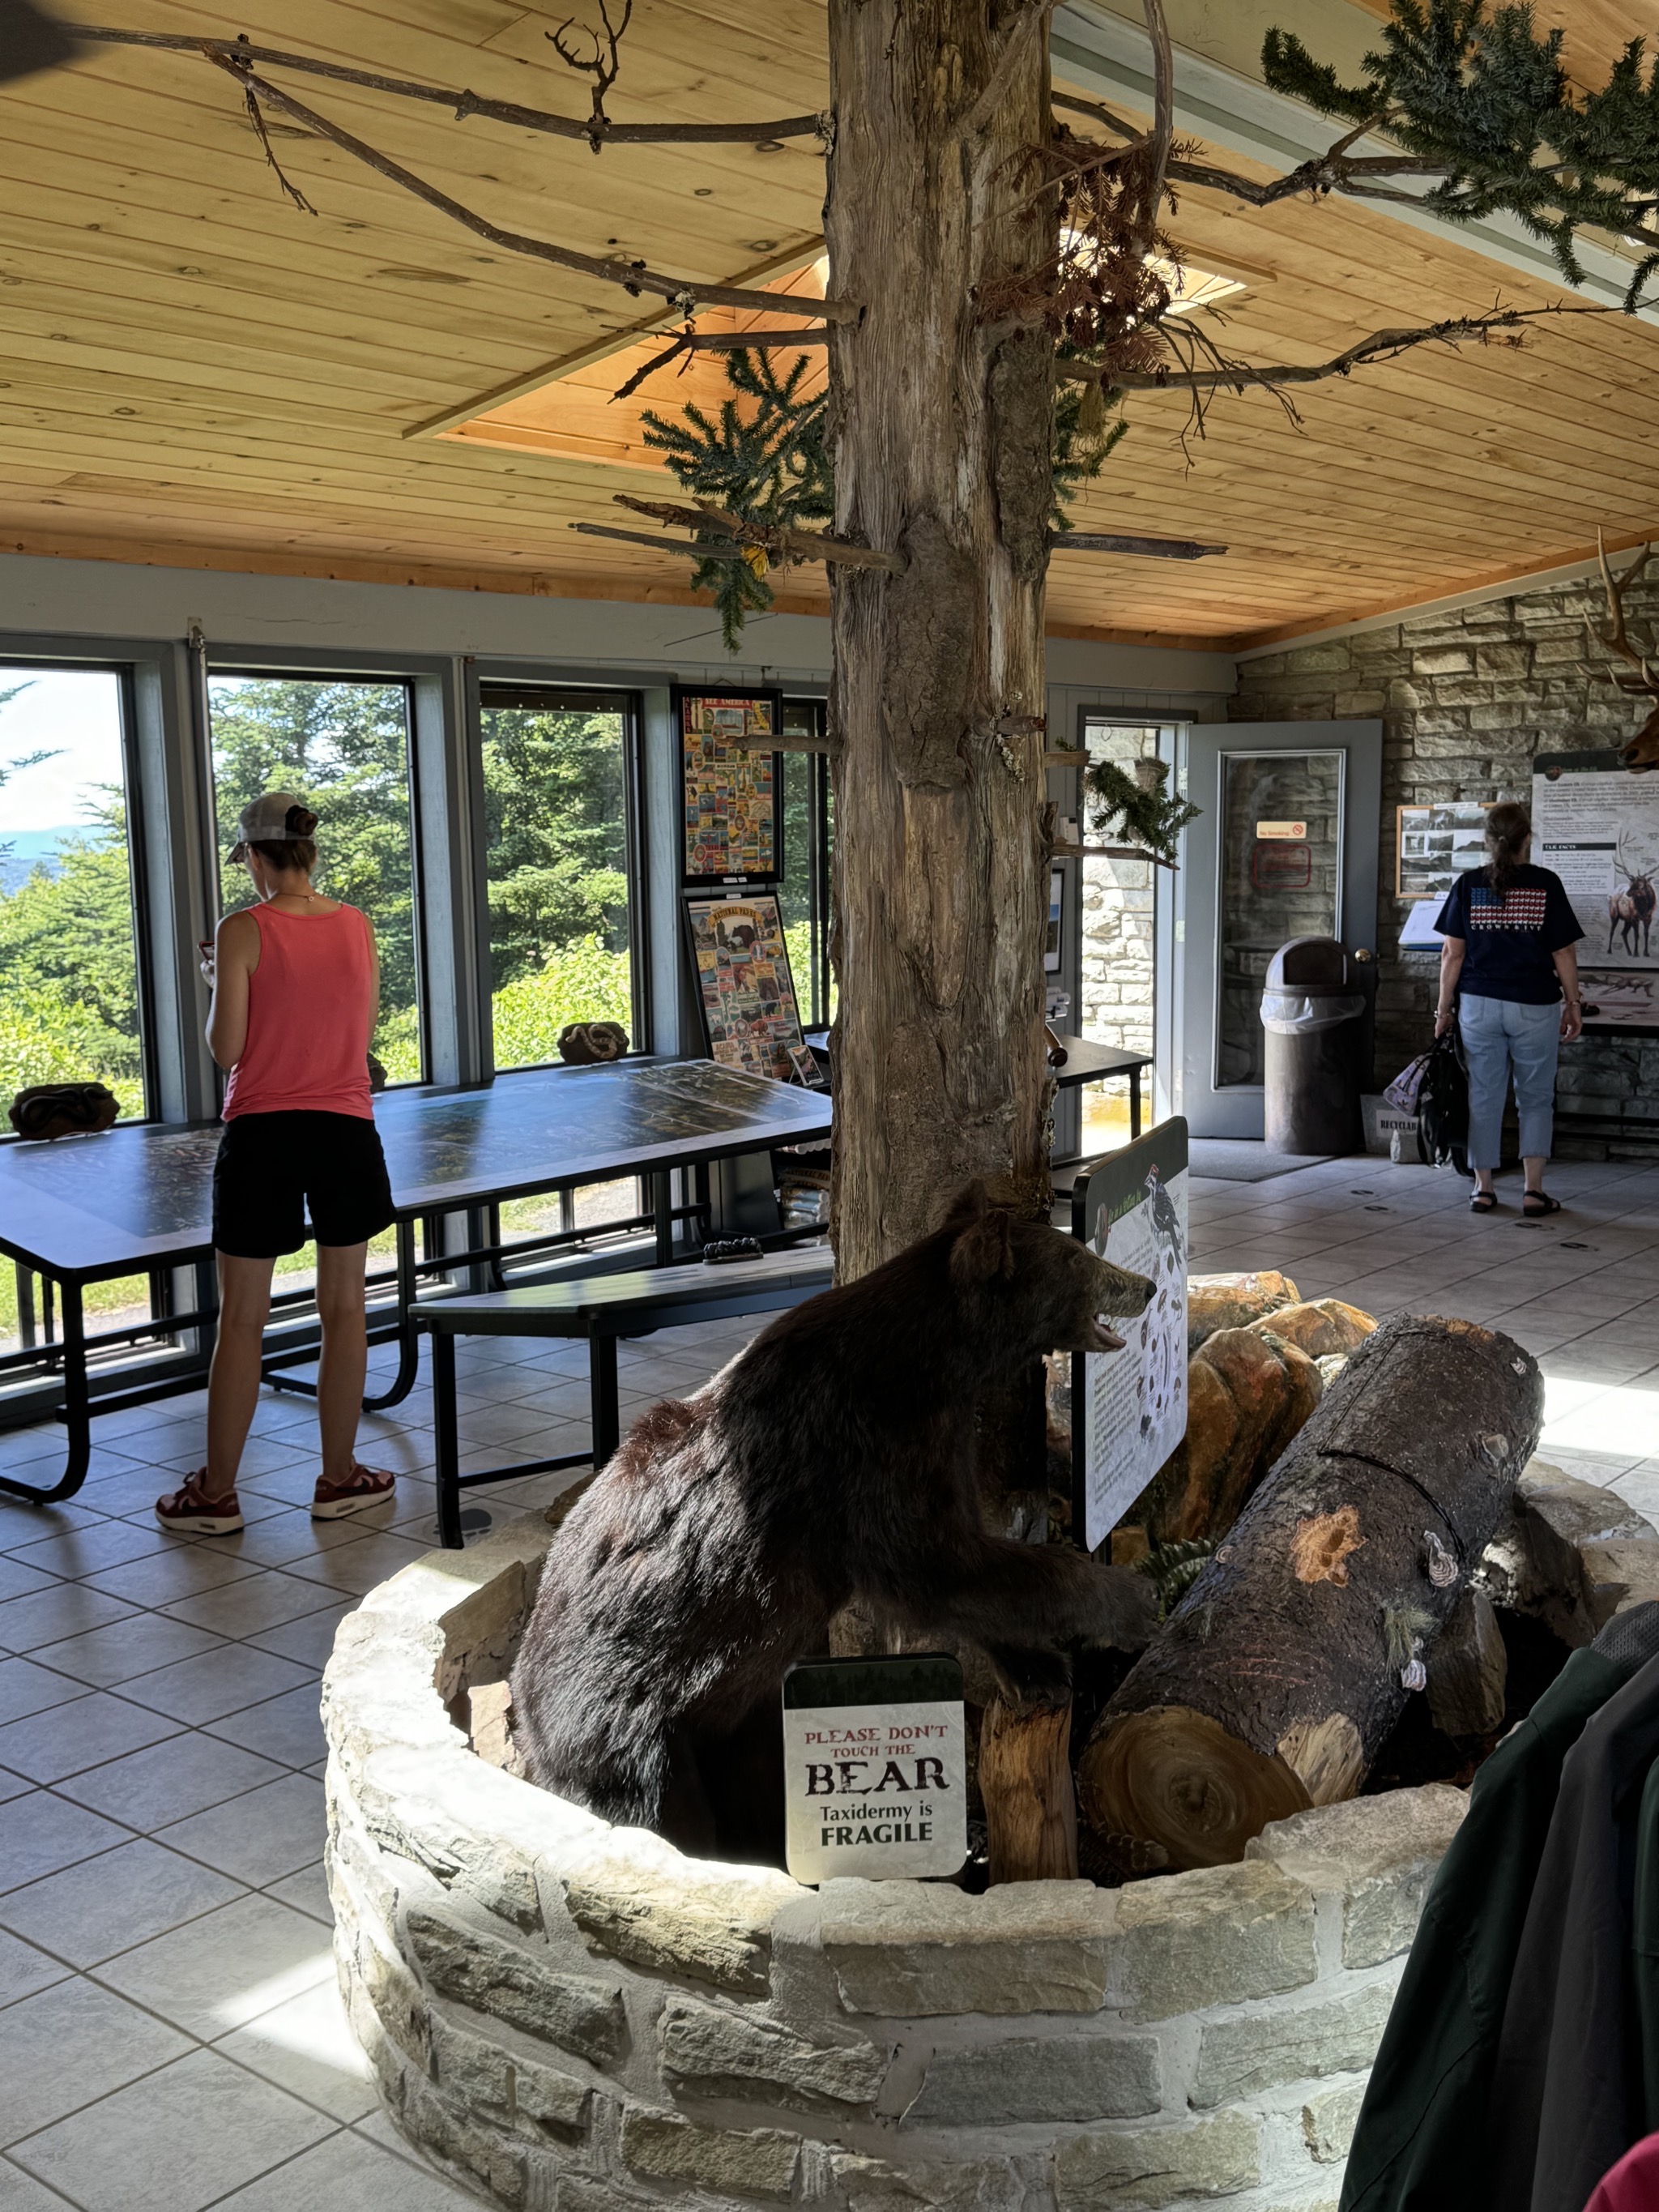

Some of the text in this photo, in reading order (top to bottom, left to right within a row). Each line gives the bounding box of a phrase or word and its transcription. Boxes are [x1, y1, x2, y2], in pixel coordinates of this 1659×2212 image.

[713, 907, 739, 920] NATIONAL
[740, 907, 757, 917] PARKS
[804, 1724, 948, 1744] PLEASE DON'T
[830, 1744, 916, 1758] TOUCH THE
[804, 1757, 951, 1796] BEAR
[820, 1800, 933, 1822] Taxidermy is
[821, 1821, 933, 1847] FRAGILE
